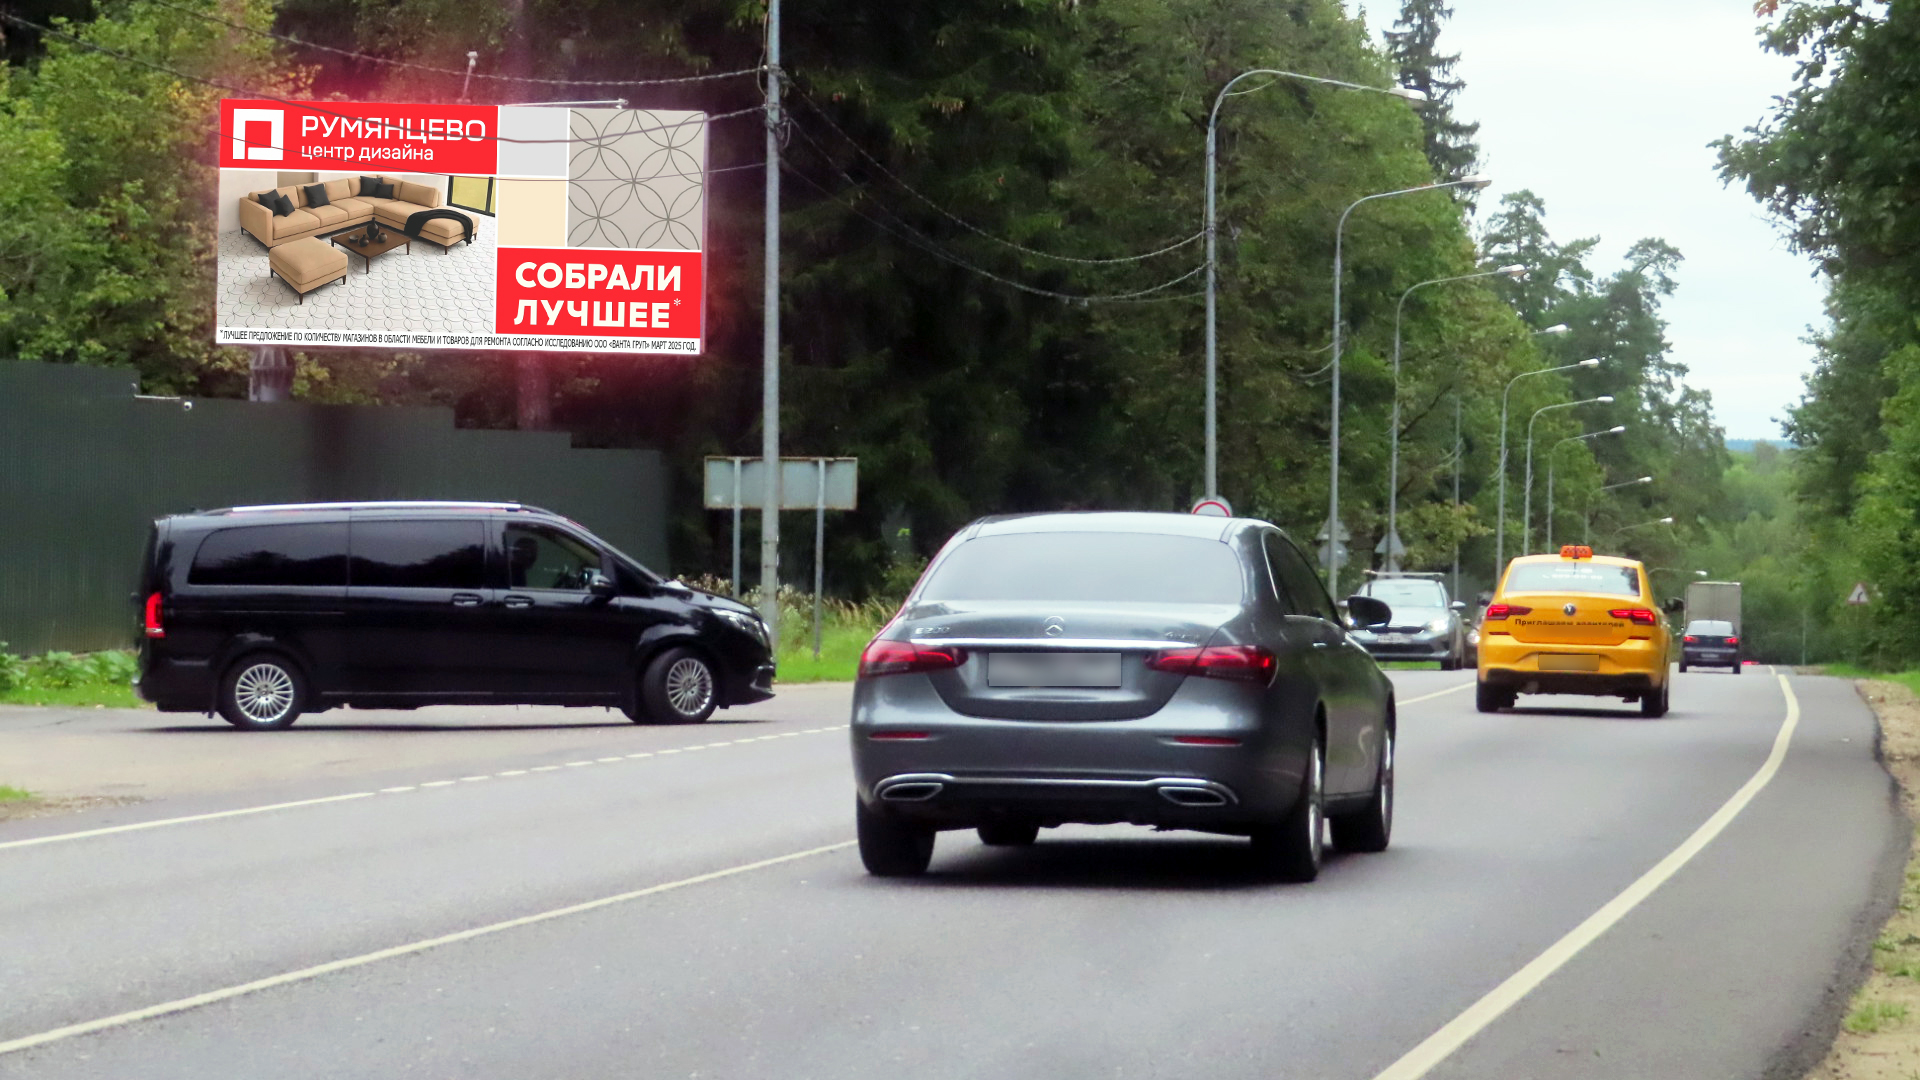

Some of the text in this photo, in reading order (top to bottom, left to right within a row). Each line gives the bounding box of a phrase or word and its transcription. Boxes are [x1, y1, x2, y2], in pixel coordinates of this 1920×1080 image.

[301, 116, 486, 144] РУМЯНЦЕВО
[301, 144, 434, 162] центр дизайна
[515, 261, 681, 291] СОБРАЛИ
[249, 331, 292, 342] ПРЕДЛОЖЕНИЕ
[294, 332, 302, 341] ПО
[304, 332, 341, 342] КОЛИЧЕСТВУ
[342, 333, 378, 343] МАГАЗИНОВ
[384, 334, 411, 344] ОБЛАСТИ
[412, 335, 435, 344] МЕБЕЛИ
[436, 335, 442, 344] И
[443, 335, 470, 345] ТОВАРОВ
[470, 336, 483, 346] ДЛЯ
[484, 337, 511, 346] РЕМОНТА
[512, 337, 544, 347] СОГЛАСНО
[545, 338, 593, 349] ИССЛЕДОВАНИЮ
[594, 340, 607, 348] ООО
[651, 341, 668, 350] МАРТ
[668, 341, 682, 350] 2025
